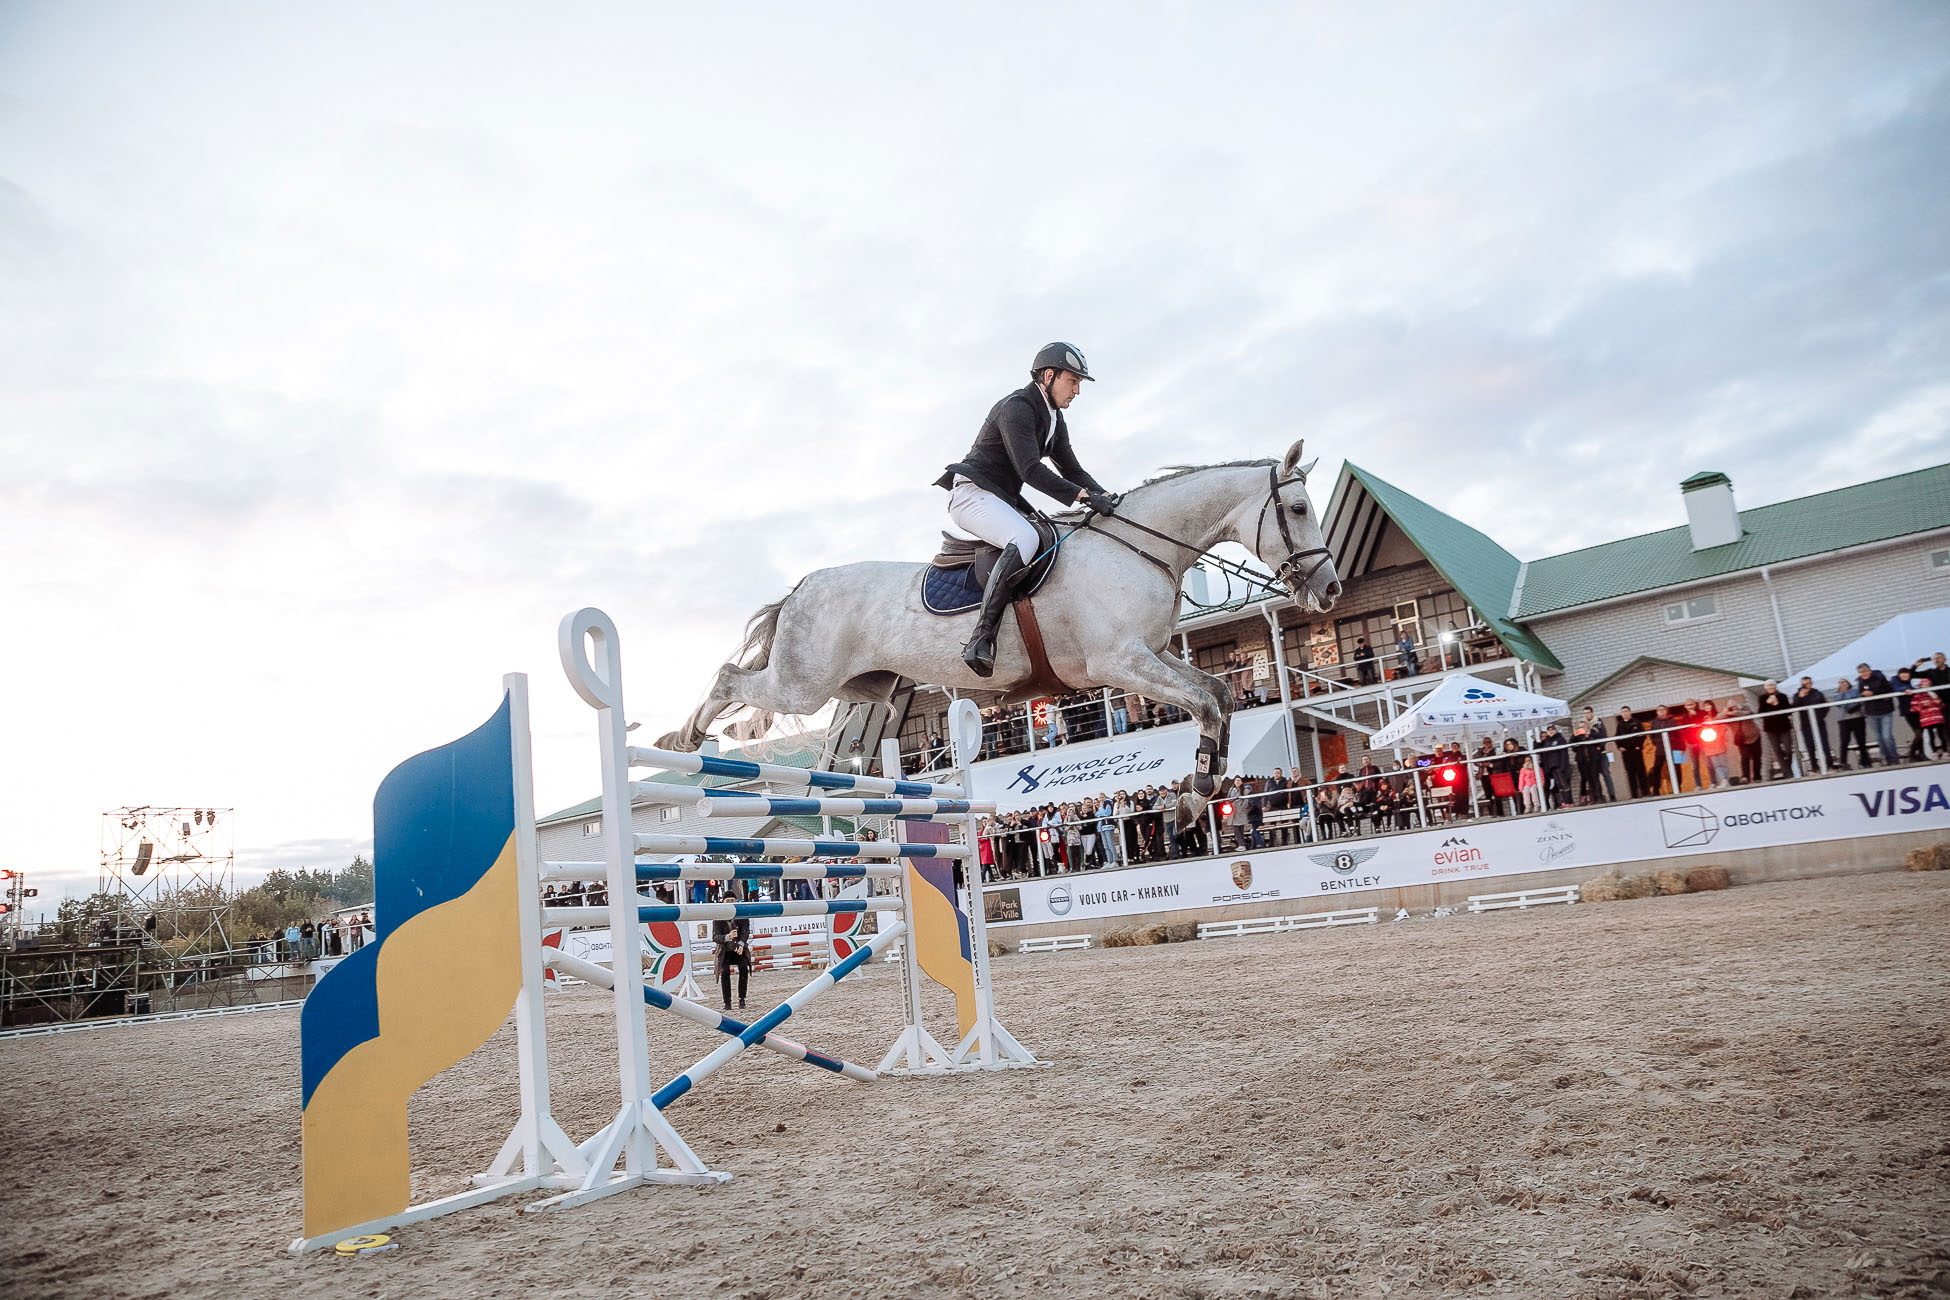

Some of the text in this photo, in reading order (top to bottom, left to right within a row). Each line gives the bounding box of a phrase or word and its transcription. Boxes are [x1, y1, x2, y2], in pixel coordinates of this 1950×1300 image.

[1050, 751, 1141, 775] NIKOLO'S
[1044, 759, 1164, 788] HORSE CLUB
[1848, 784, 1950, 817] VISA
[1723, 805, 1824, 827] авантаж
[1434, 848, 1481, 865] evian
[1431, 867, 1460, 875] DRINK
[1320, 875, 1381, 891] BENTLEY
[1079, 892, 1107, 905] VOLVO
[1111, 889, 1128, 902] CAR
[1137, 884, 1179, 899] KHARKIV
[1212, 890, 1280, 902] PORSCHE
[1002, 899, 1017, 909] Park
[1003, 910, 1019, 919] Ville
